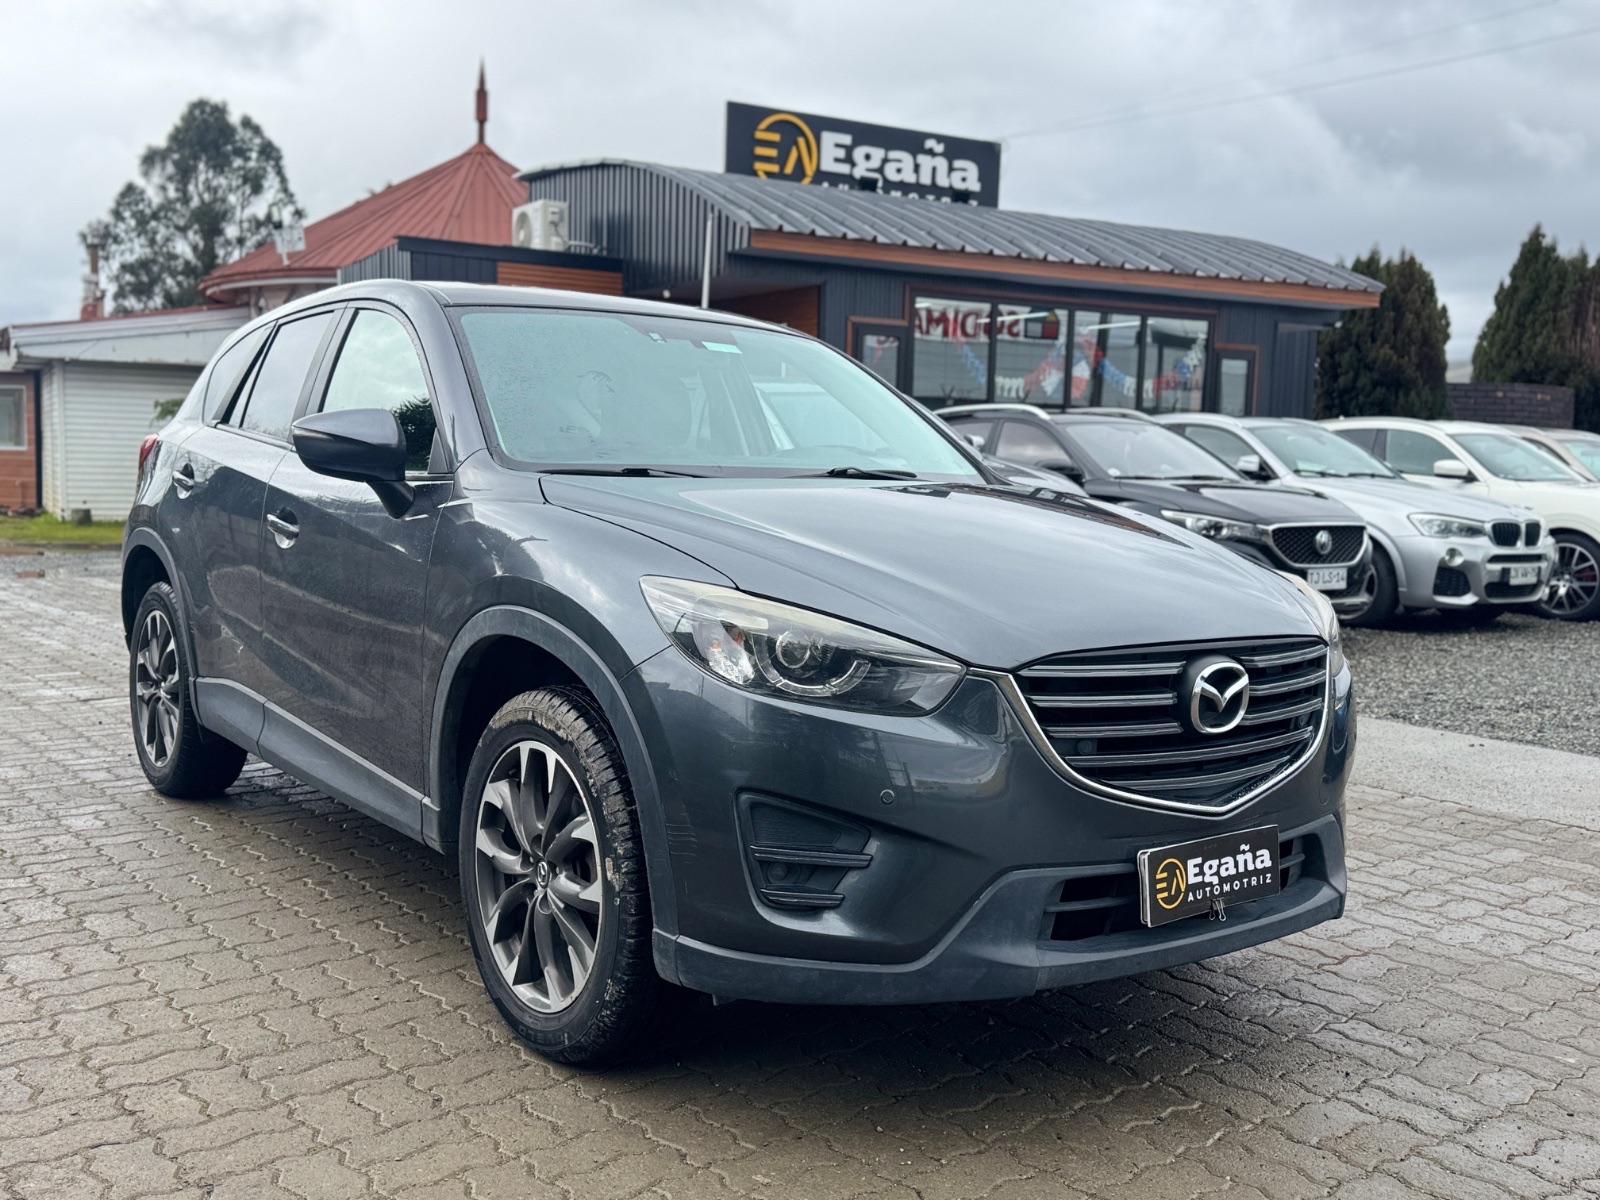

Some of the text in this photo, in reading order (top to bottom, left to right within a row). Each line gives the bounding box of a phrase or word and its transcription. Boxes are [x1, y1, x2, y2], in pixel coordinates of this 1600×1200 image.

[820, 130, 981, 192] Egaña
[1187, 843, 1272, 885] Egaña
[1187, 873, 1272, 902] AUTOMOTRIZ
